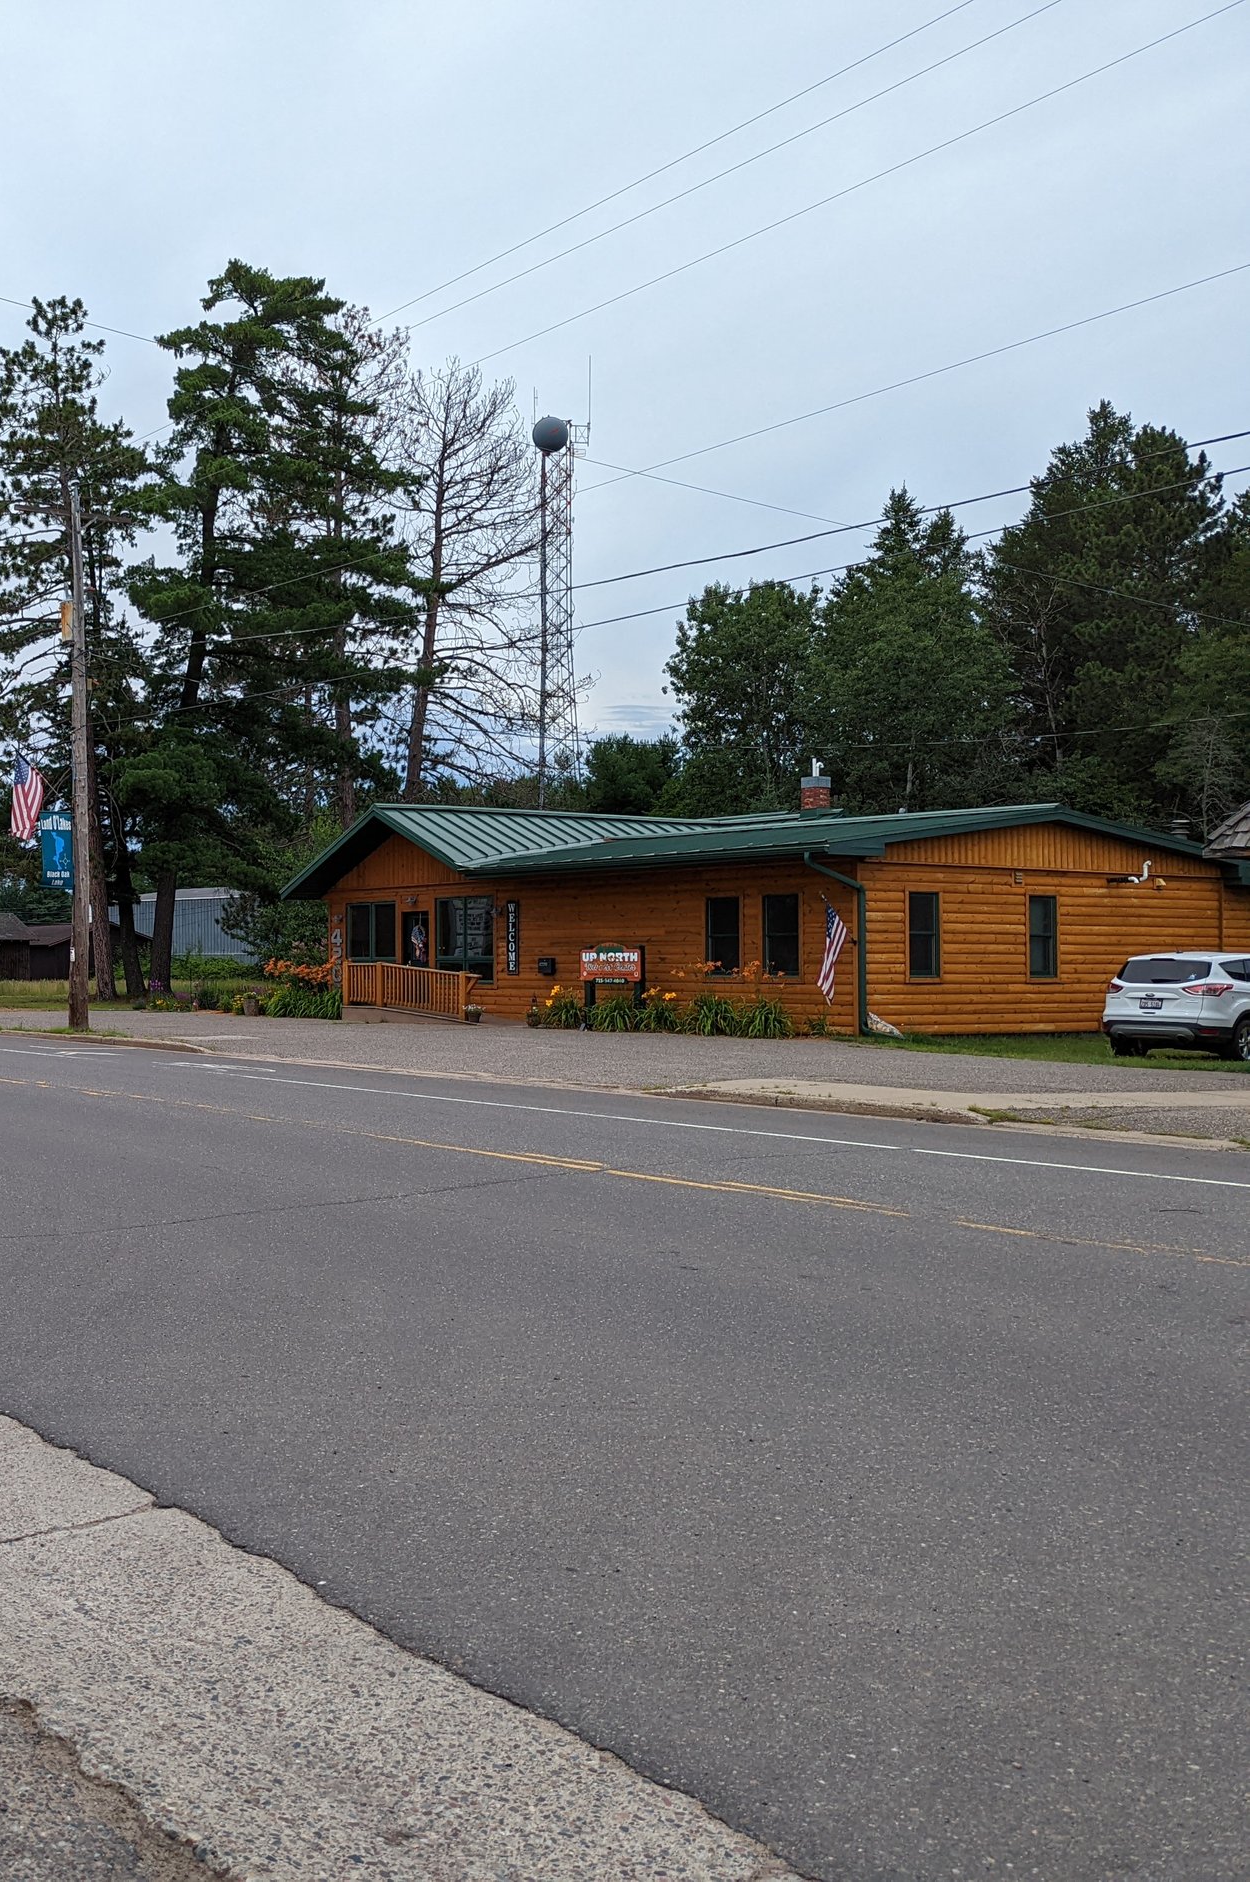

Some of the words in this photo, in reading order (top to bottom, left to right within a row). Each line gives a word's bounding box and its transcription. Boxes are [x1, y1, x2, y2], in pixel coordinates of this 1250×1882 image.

[41, 816, 52, 830] Land
[507, 903, 516, 971] WELCOME
[582, 952, 597, 962] UP
[600, 952, 638, 962] NORTH
